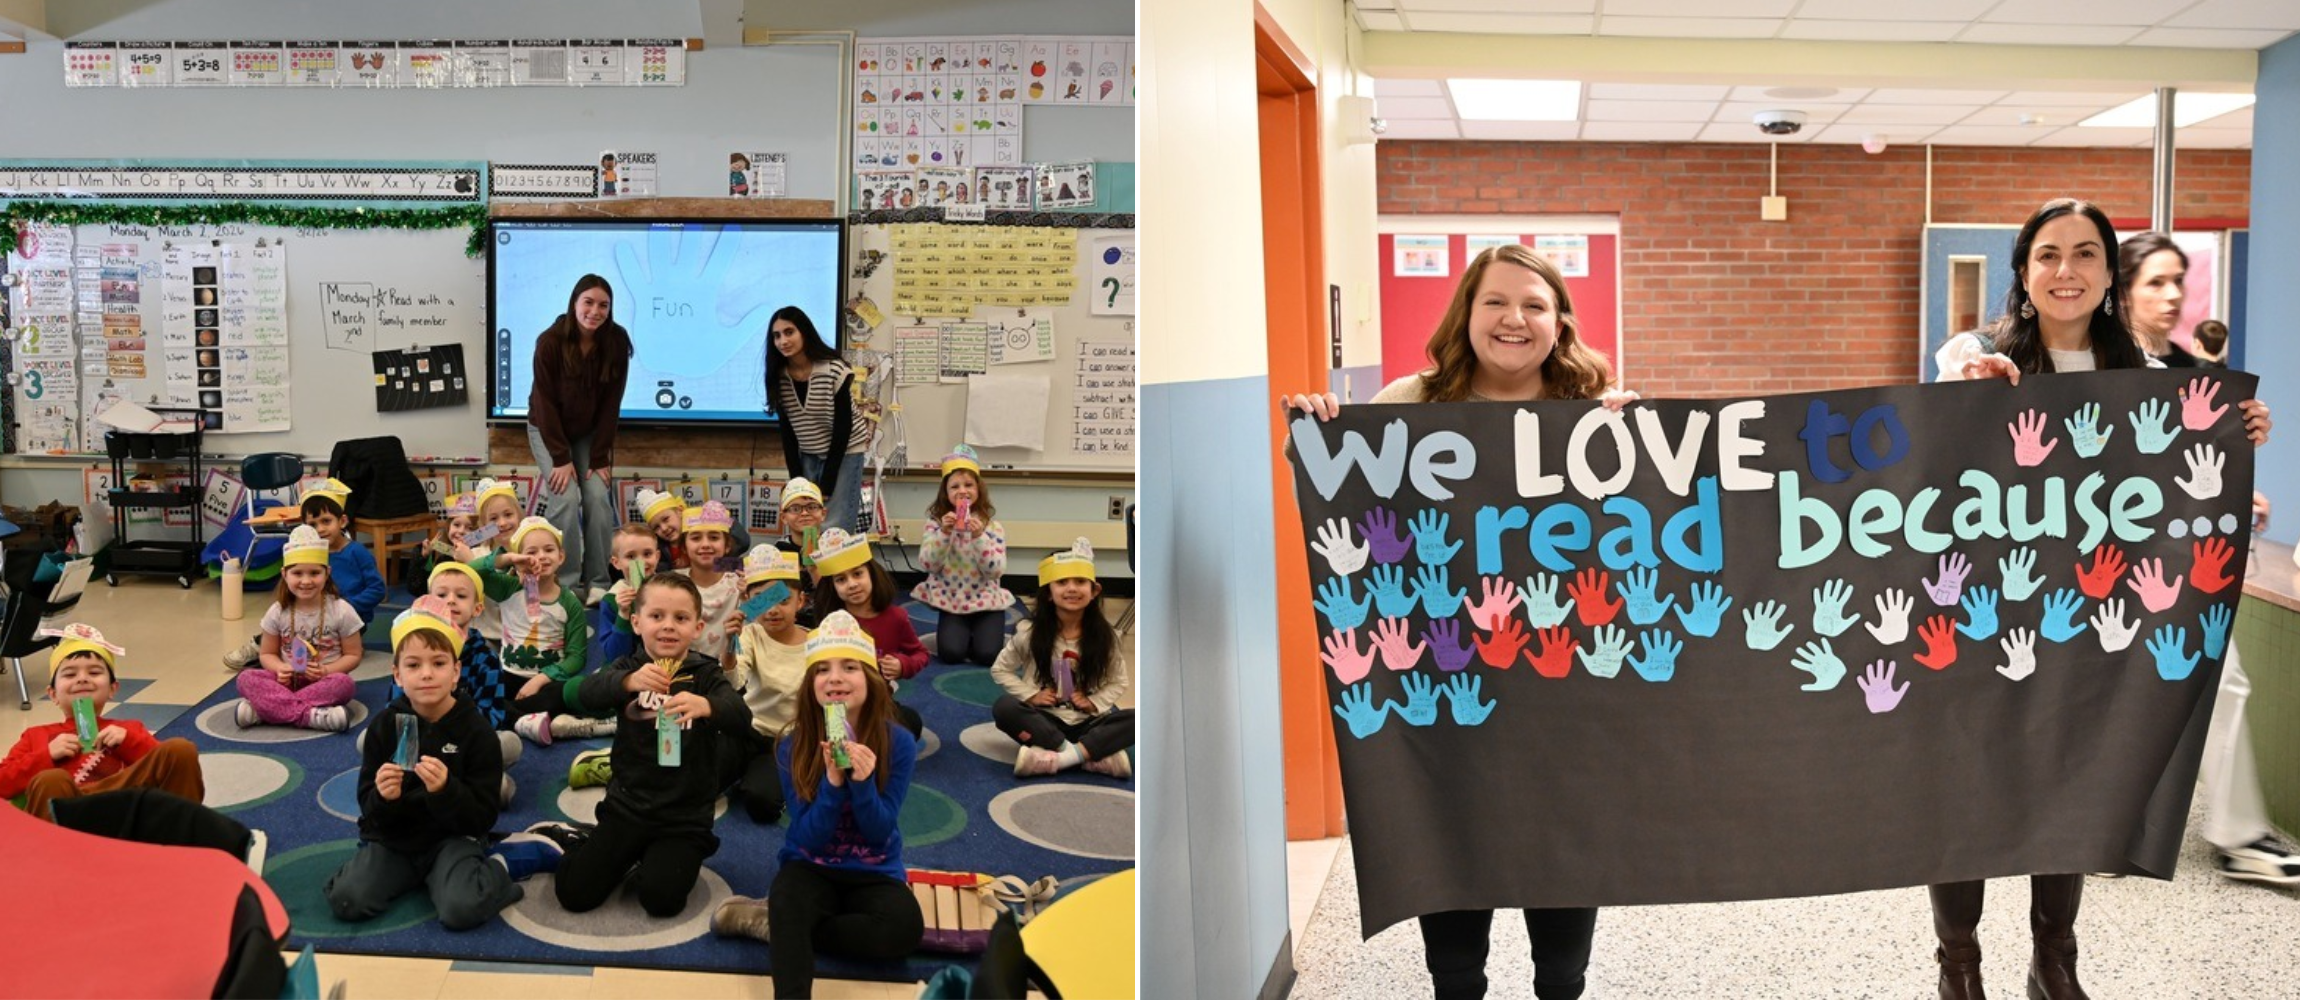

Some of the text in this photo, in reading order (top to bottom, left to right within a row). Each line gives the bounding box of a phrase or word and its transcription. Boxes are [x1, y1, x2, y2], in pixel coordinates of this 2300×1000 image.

[886, 48, 898, 57] Bb
[930, 46, 943, 57] Dd
[1000, 43, 1015, 57] Gg
[130, 54, 162, 64] 4+5=9
[182, 59, 220, 71] 5+3=8
[975, 78, 993, 88] Mm
[884, 110, 896, 122] Pp
[998, 138, 1010, 148] Bb
[617, 152, 657, 164] SPEAKERS
[998, 151, 1012, 162] Dd
[6, 173, 452, 193] Jj Kk Ll Mm Nn Oo Pp Qq Rr Ss Tt Uu Vv Ww Xx Yy Zz
[110, 225, 150, 241] Monday
[158, 226, 192, 237] March
[215, 226, 245, 237] 2026
[326, 284, 371, 308] Monday
[389, 288, 412, 306] Read
[418, 294, 441, 306] with
[107, 304, 138, 314] Health
[651, 296, 694, 319] Fun
[332, 309, 366, 325] March
[378, 309, 448, 329] family member
[20, 326, 39, 354] 2
[344, 326, 363, 344] 2nd
[1092, 347, 1107, 357] can
[1109, 346, 1128, 356] read
[1089, 363, 1103, 373] can
[24, 370, 44, 399] 3
[1086, 380, 1100, 390] can
[1102, 380, 1115, 388] use
[1083, 411, 1098, 420] can
[1103, 407, 1125, 420] GIVE
[1083, 427, 1097, 437] can
[1100, 426, 1114, 436] use
[1083, 442, 1097, 452] can
[1100, 439, 1109, 451] be
[1289, 398, 1912, 502] We LOVE to
[100, 476, 108, 489] 2
[219, 481, 230, 494] 5
[682, 486, 694, 499] 16
[721, 486, 732, 499] 17
[760, 486, 771, 499] 18
[1474, 474, 1722, 575] read
